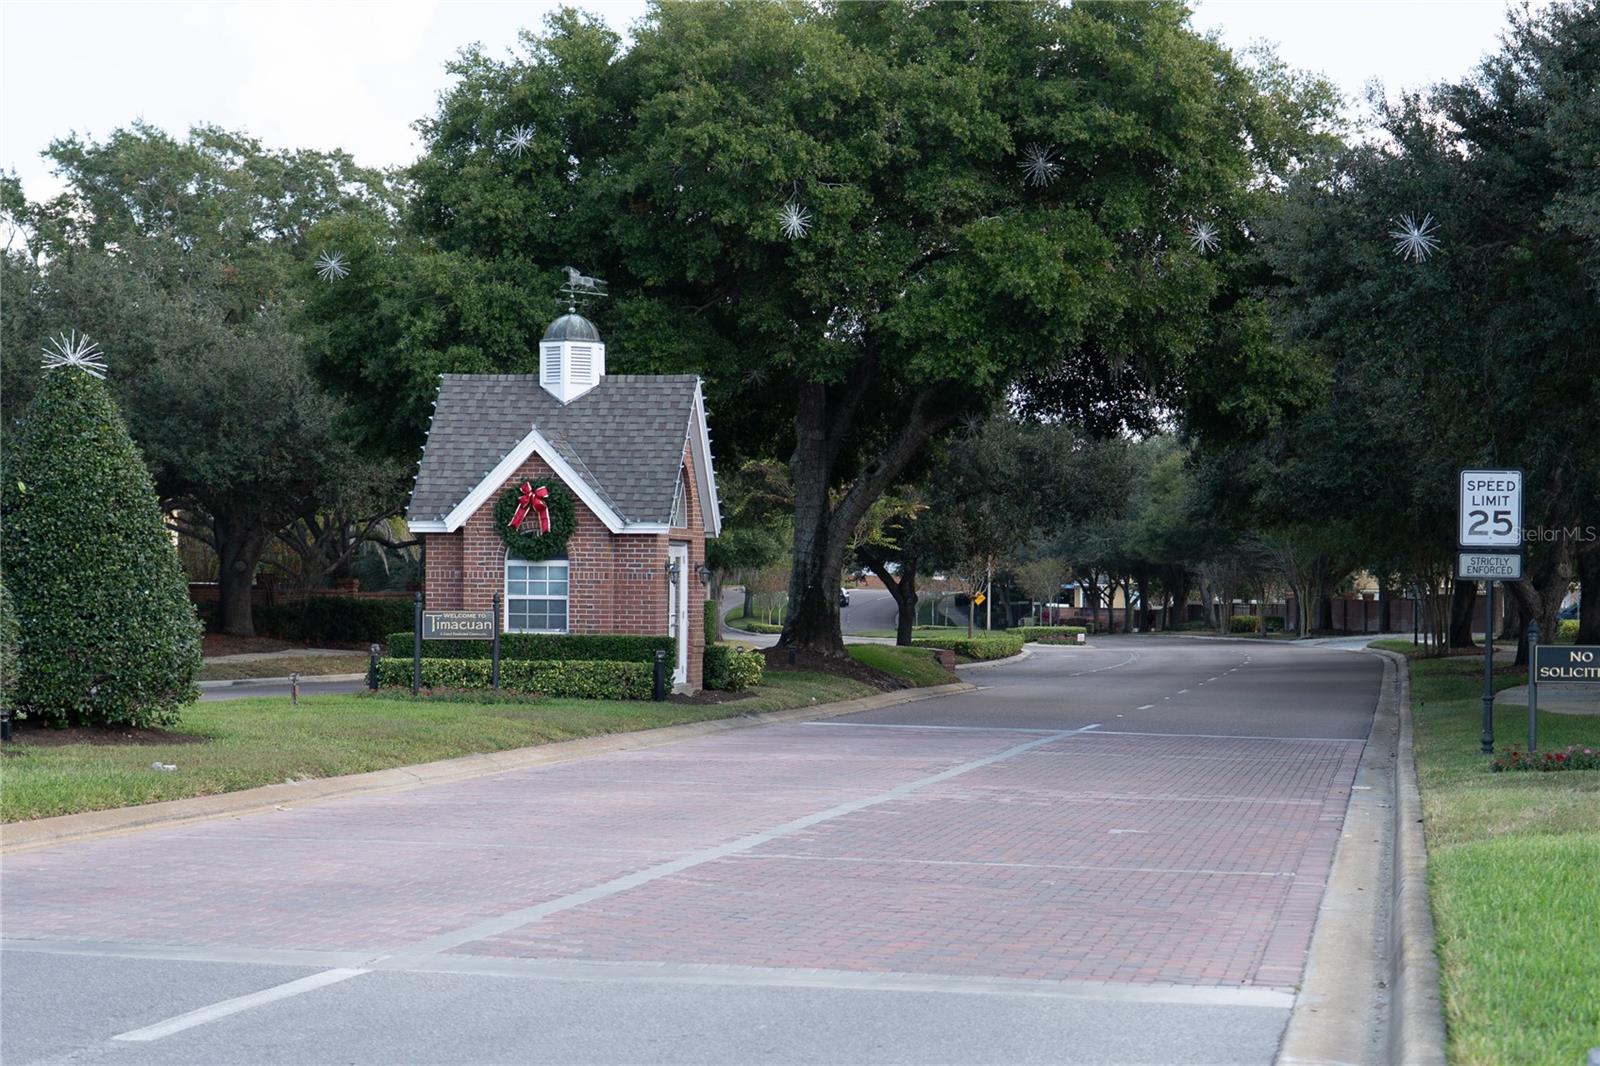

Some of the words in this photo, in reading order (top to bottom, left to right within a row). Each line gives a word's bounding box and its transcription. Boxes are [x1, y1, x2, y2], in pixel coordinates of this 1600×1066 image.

[1467, 480, 1516, 492] SPEED
[1472, 495, 1510, 507] LIMIT
[1468, 510, 1513, 536] 25
[1470, 557, 1510, 566] STRICTLY
[1466, 566, 1513, 576] ENFORCED
[425, 614, 492, 632] Timacuan
[1570, 651, 1594, 663] NO
